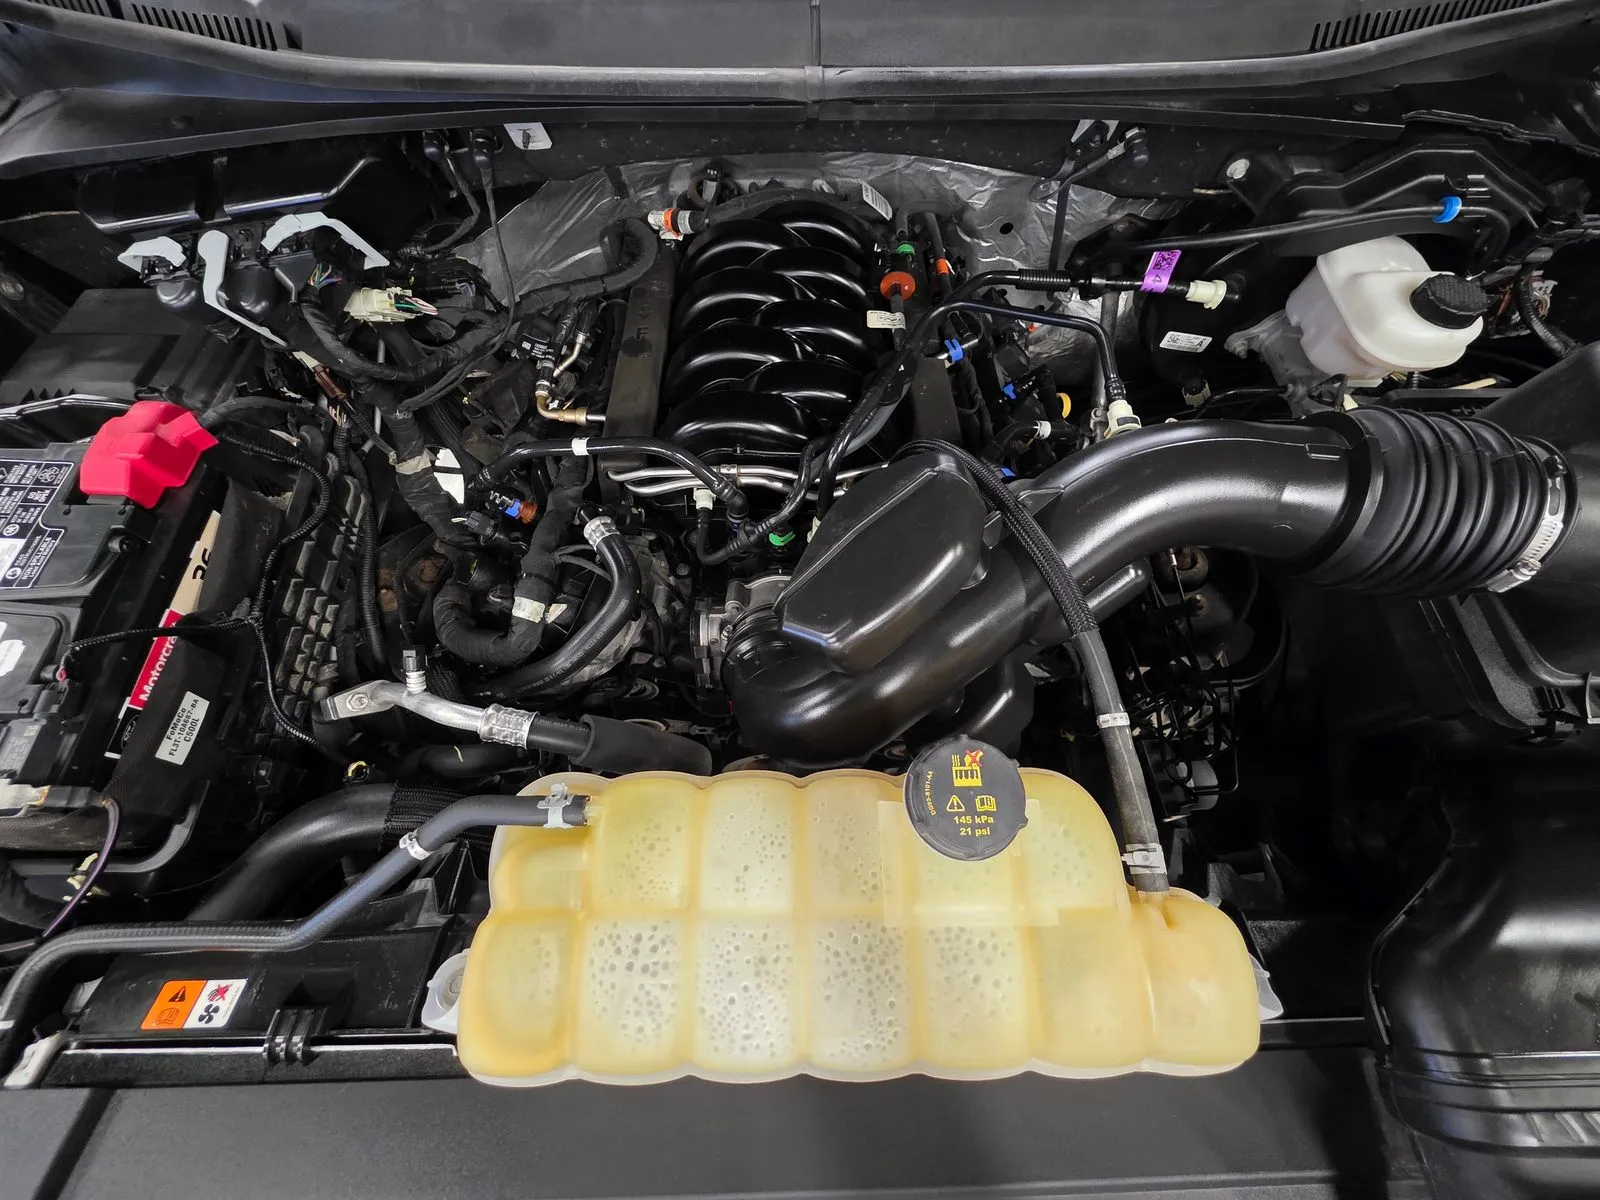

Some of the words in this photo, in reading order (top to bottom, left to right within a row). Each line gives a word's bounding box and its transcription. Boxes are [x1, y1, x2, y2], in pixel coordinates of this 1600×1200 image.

[21, 537, 52, 579] NON-SPILLABLE
[166, 707, 187, 741] FoMoCo
[183, 716, 201, 743] C500L
[953, 815, 972, 825] 145
[975, 815, 994, 825] kPa
[959, 827, 972, 836] 21
[975, 827, 991, 837] psi
